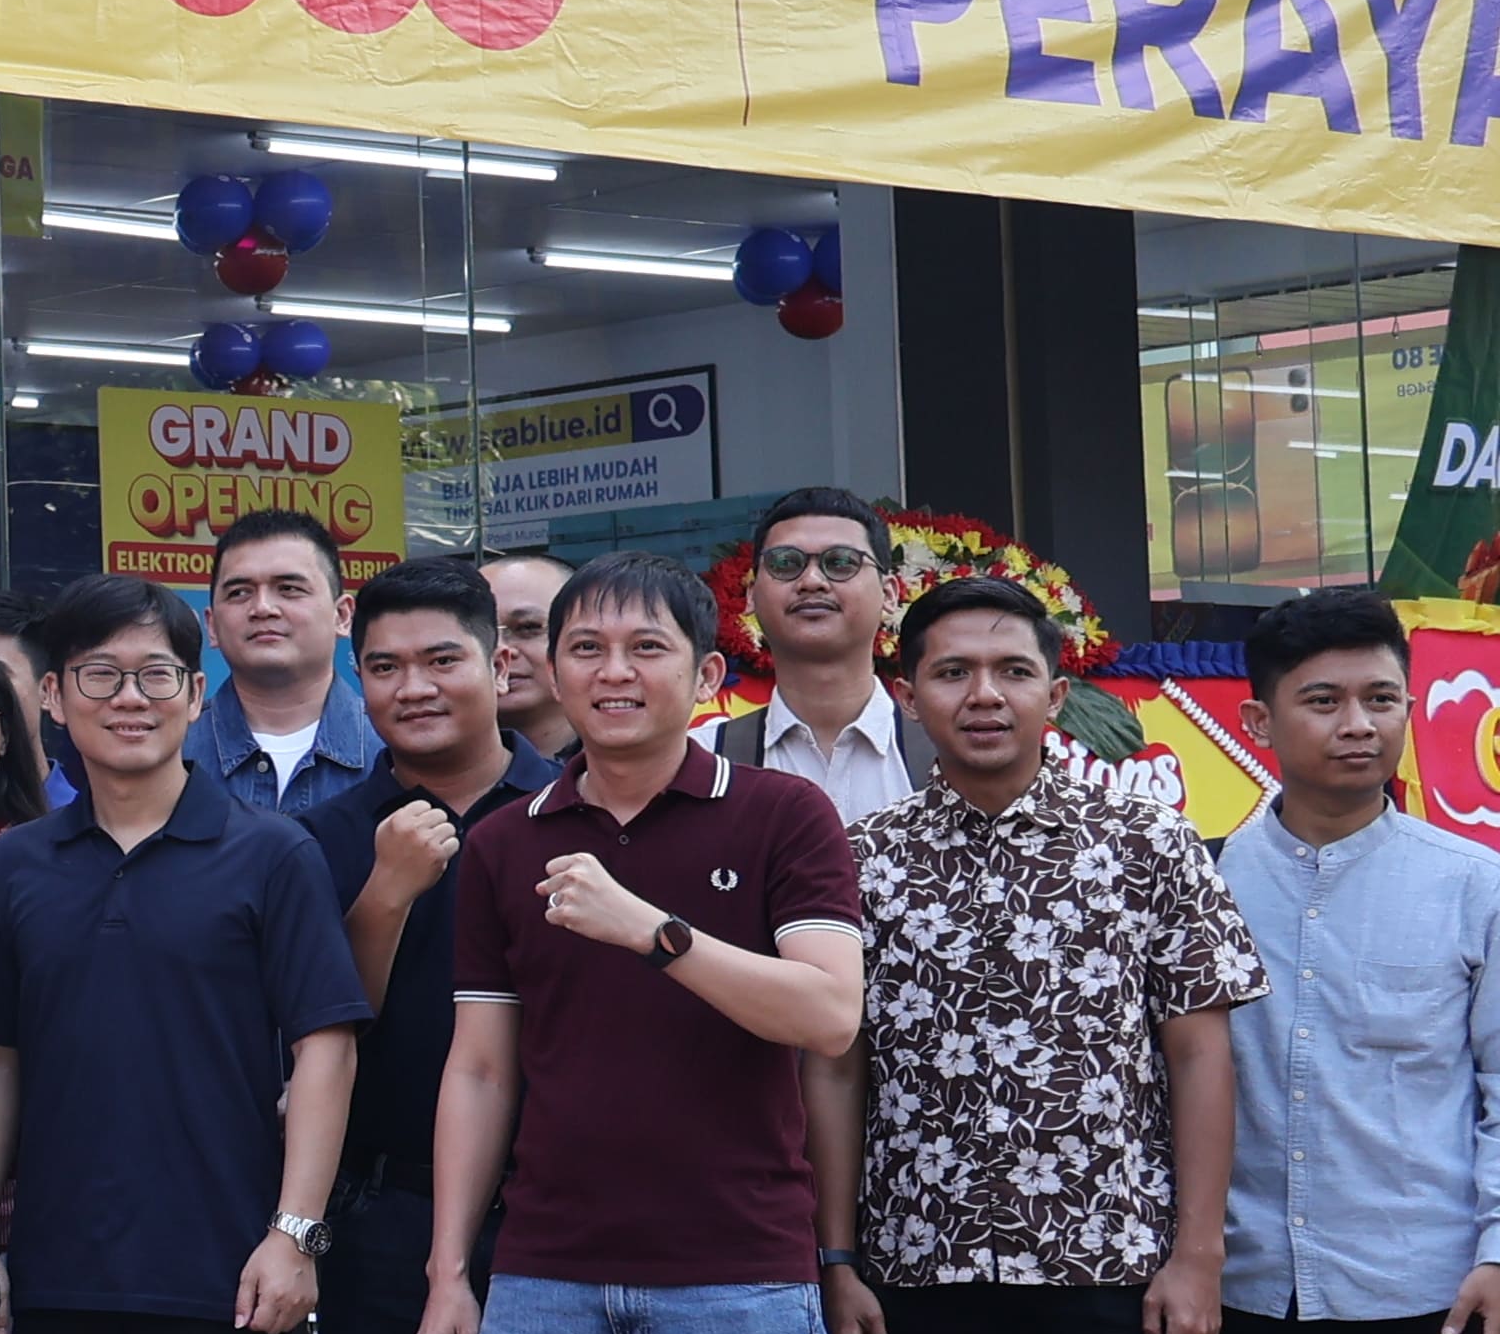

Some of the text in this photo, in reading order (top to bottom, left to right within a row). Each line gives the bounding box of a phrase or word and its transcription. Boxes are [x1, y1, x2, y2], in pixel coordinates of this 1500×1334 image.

[149, 404, 351, 471] GRAND
[442, 456, 658, 501] BELNJA LEBIH MUDAH
[514, 495, 550, 515] KLIK
[553, 488, 592, 508] DARI
[595, 482, 658, 504] RUMAH
[129, 473, 373, 545] OPENING
